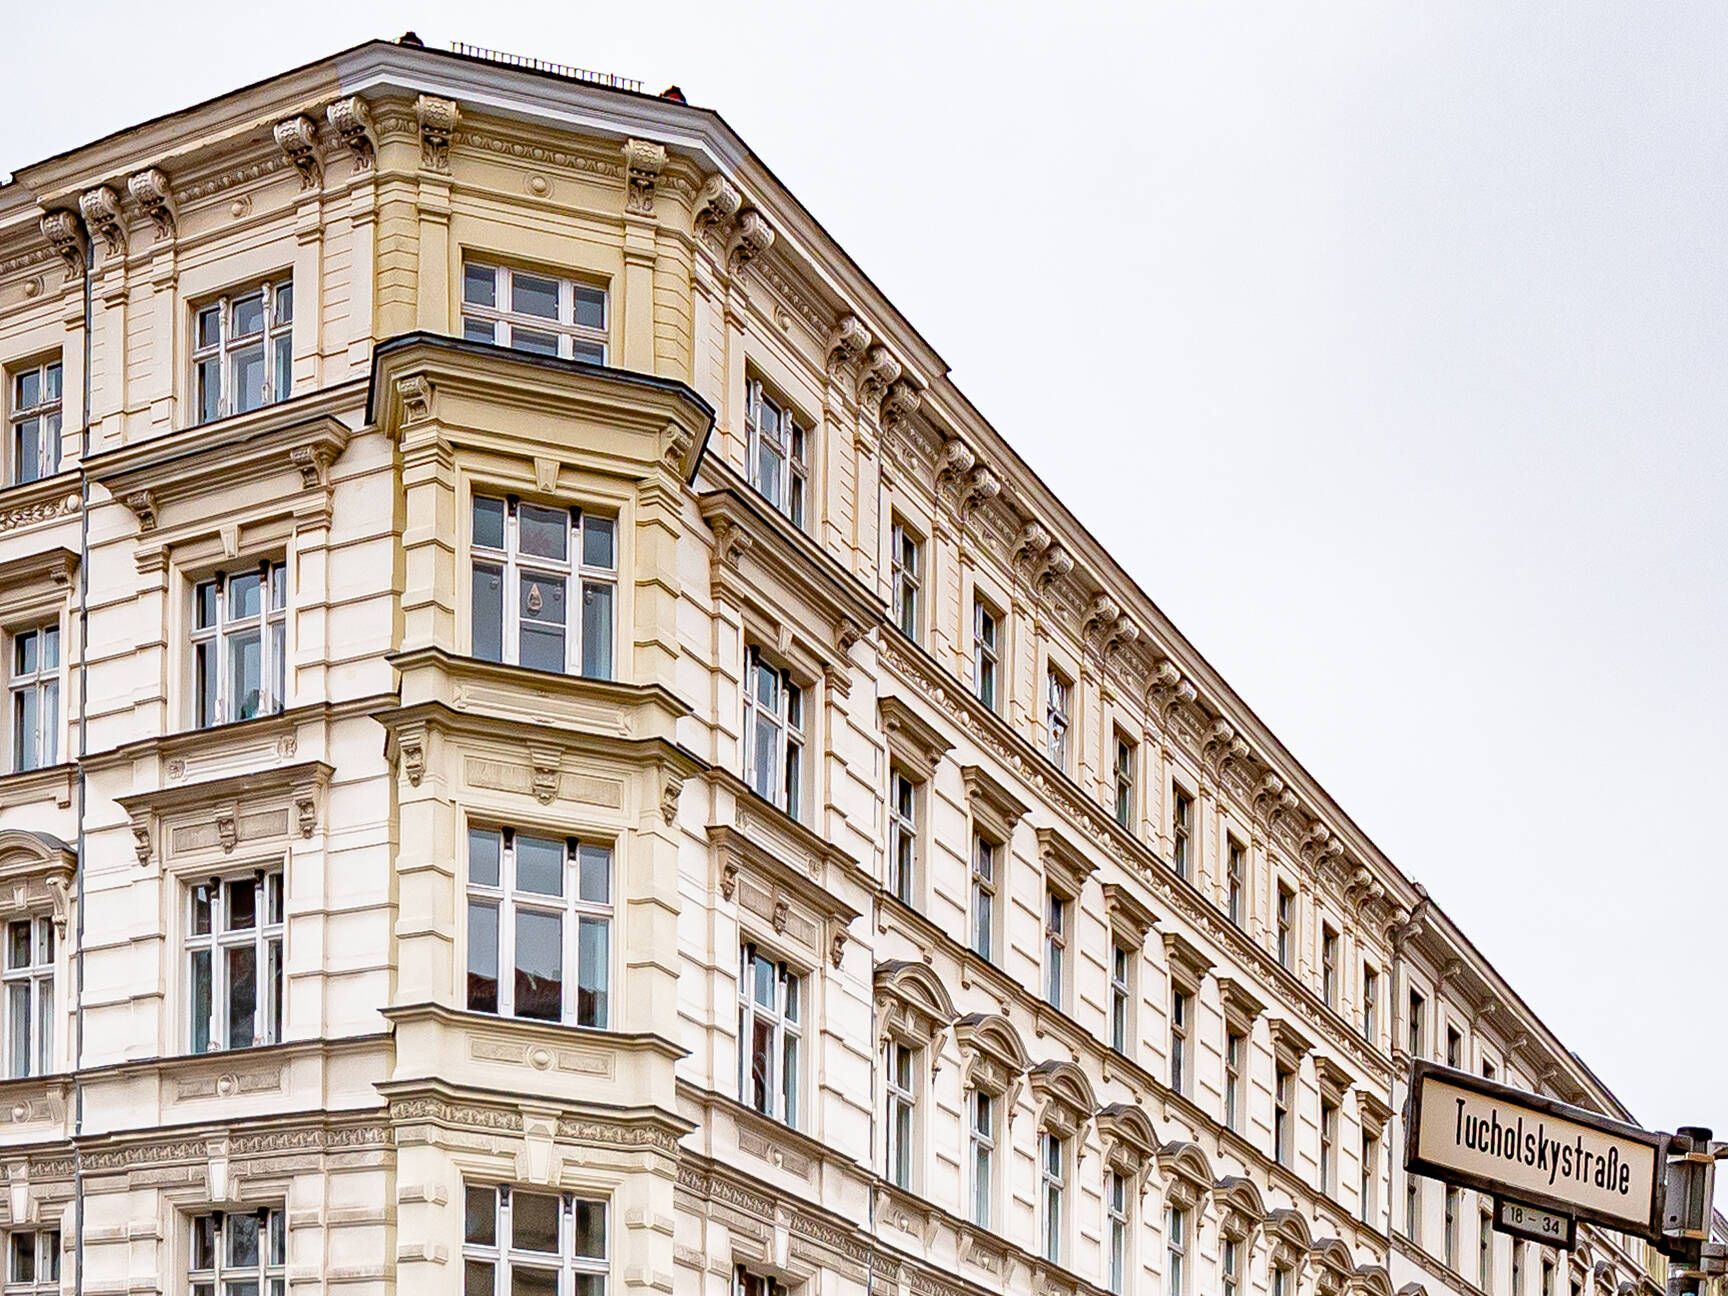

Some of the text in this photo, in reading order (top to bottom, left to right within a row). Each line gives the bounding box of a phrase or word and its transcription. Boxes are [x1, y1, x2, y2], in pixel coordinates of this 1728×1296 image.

[1455, 1097, 1630, 1196] Tucholskystraße
[1510, 1205, 1523, 1224] 18
[1542, 1216, 1560, 1235] 34
